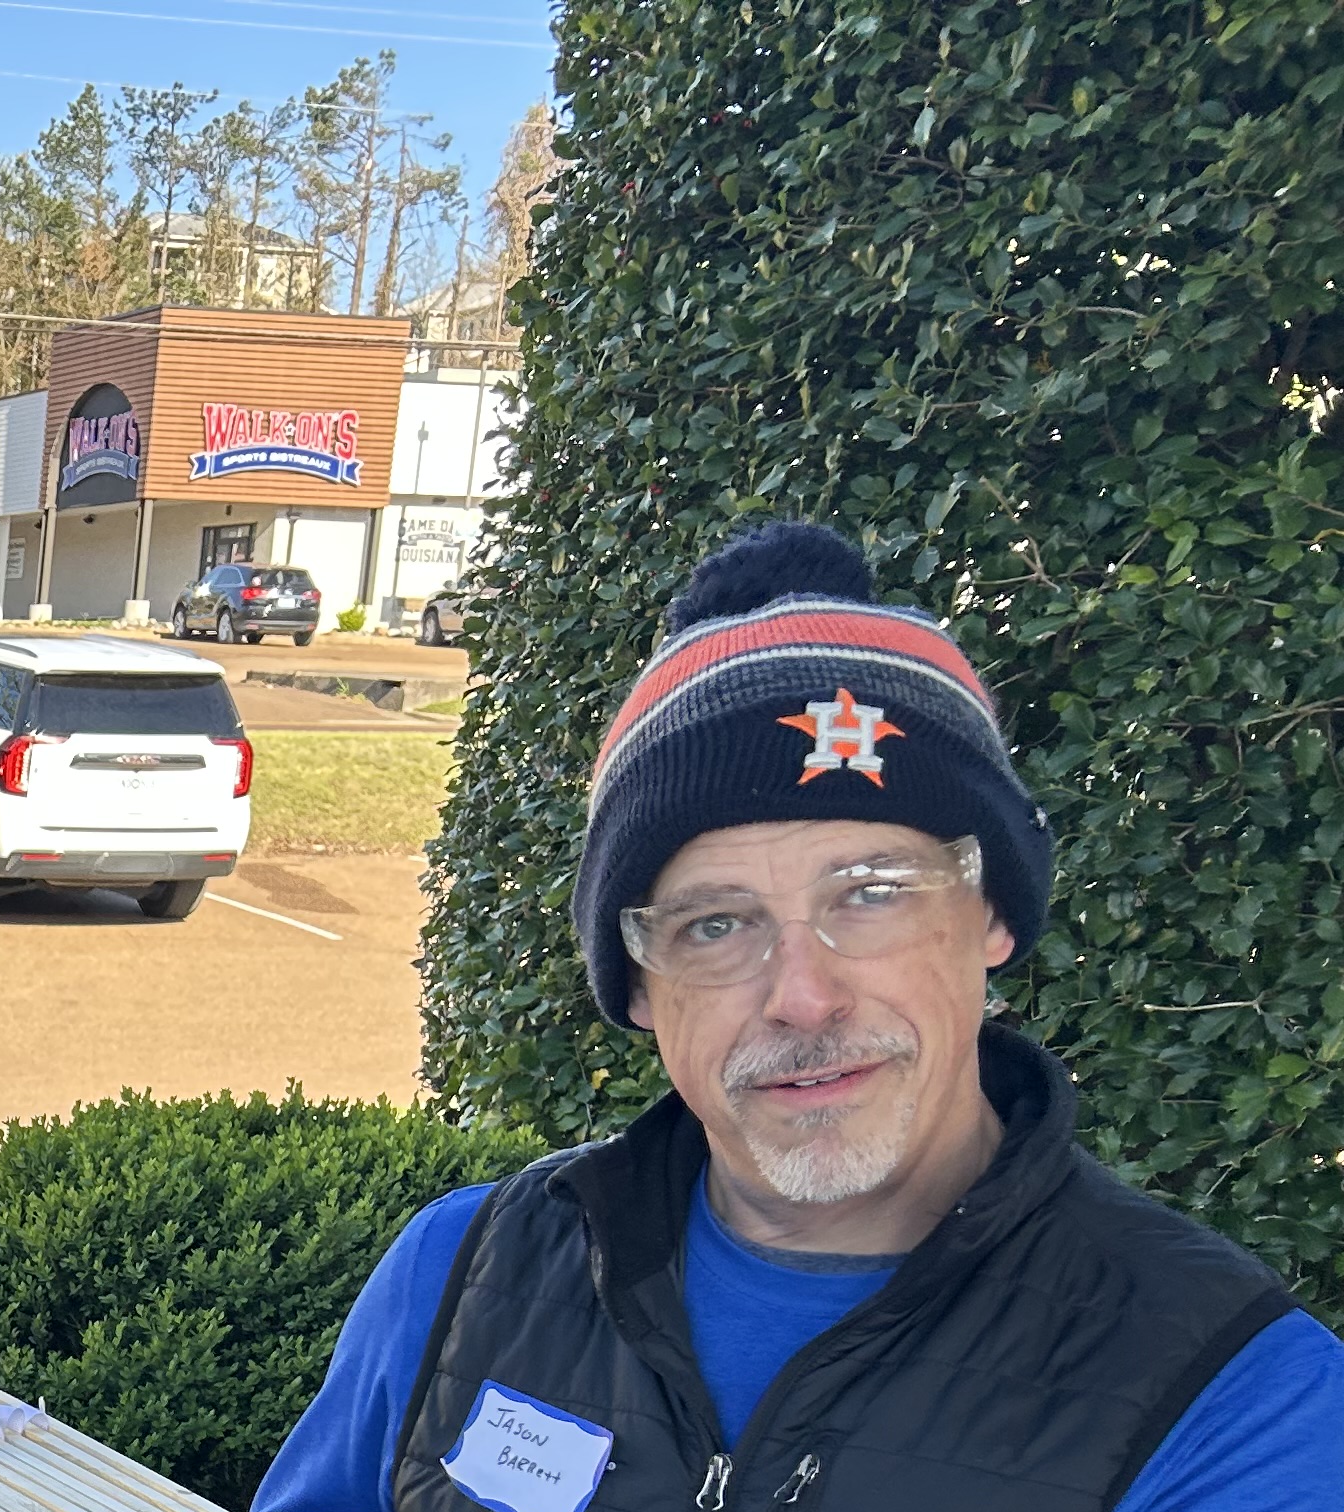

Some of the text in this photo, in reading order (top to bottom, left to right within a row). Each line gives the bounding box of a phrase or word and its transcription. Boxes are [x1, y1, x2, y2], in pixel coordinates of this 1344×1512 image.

[222, 452, 267, 467] SPORTS
[399, 548, 459, 563] OUISIAN
[805, 700, 884, 773] H
[487, 1407, 550, 1447] JASON
